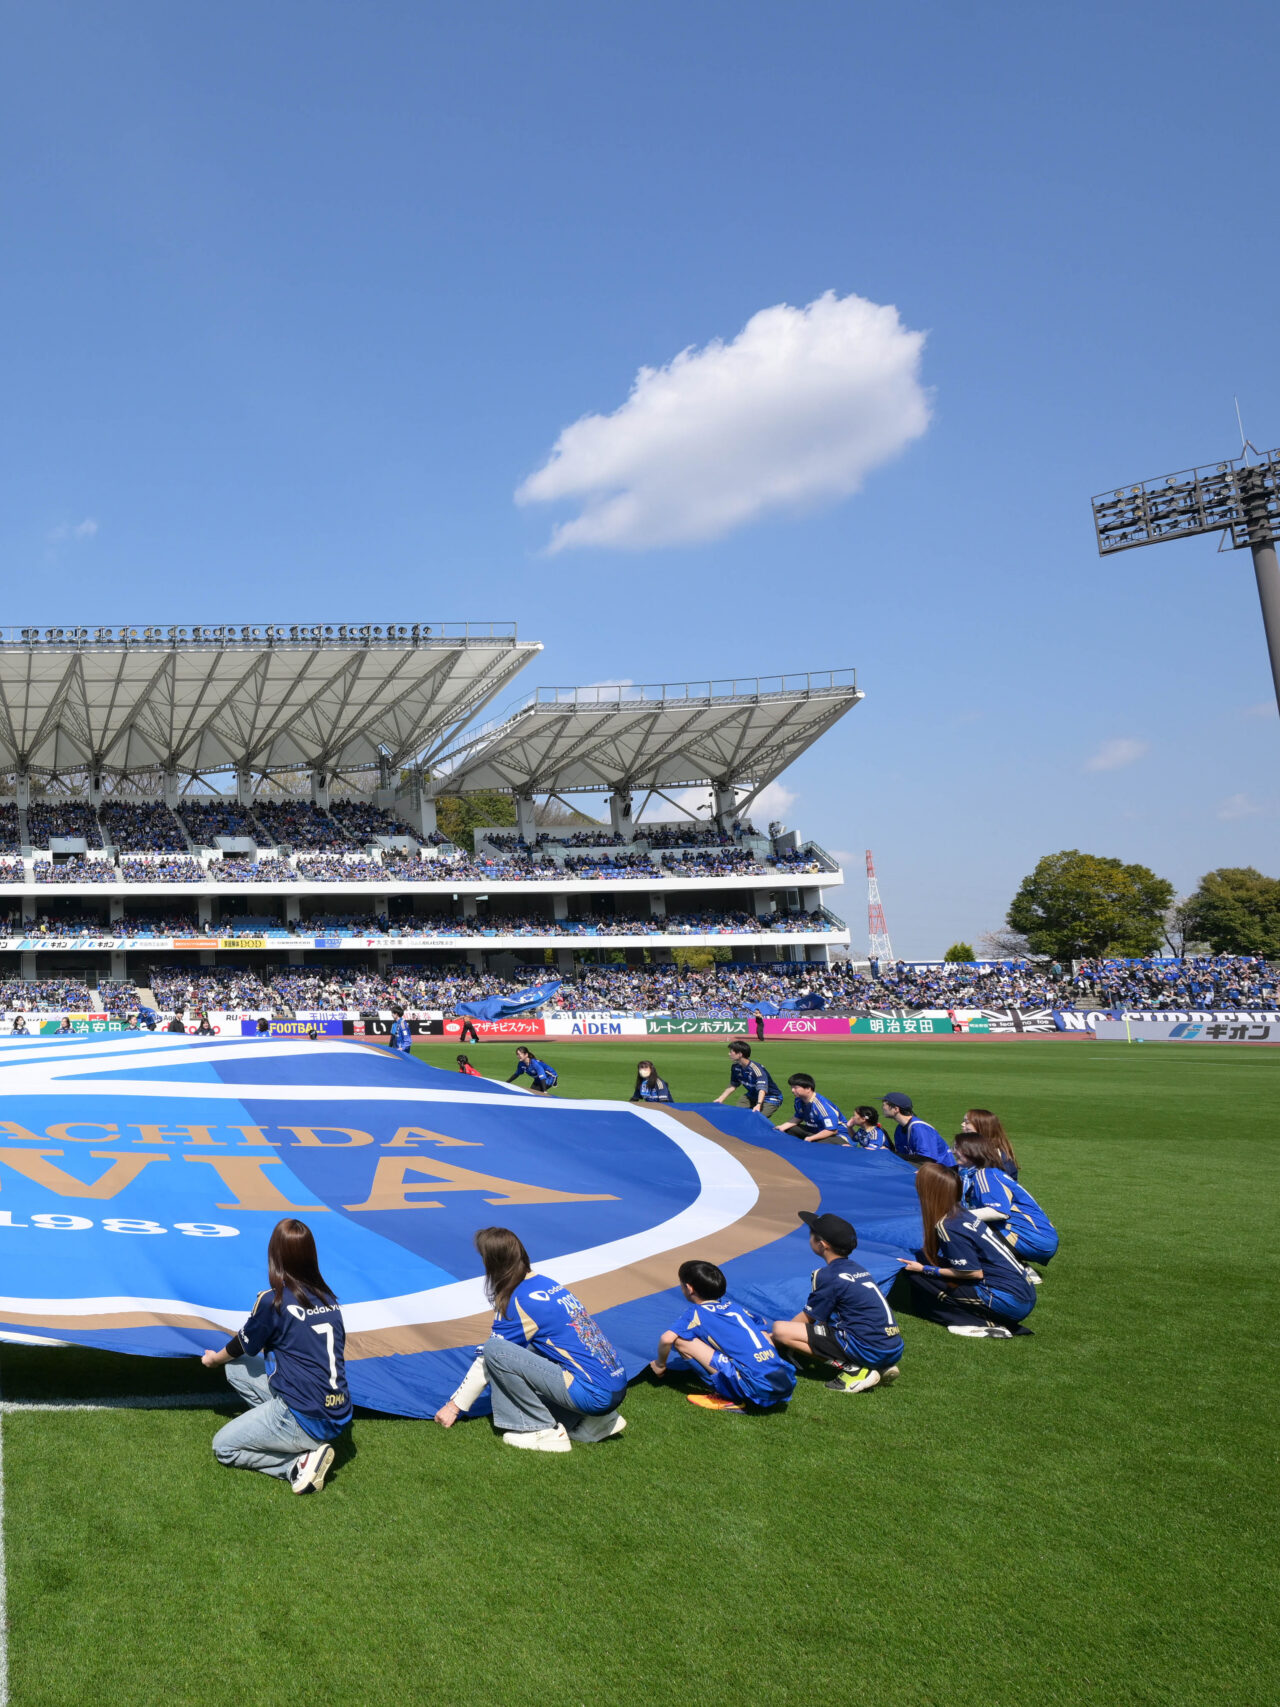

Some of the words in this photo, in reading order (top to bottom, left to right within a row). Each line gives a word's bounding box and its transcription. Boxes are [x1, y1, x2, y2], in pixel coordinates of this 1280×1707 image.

[70, 1021, 122, 1033] 治安田
[256, 1022, 327, 1033] FOOTBALL
[372, 1021, 433, 1035] いご
[472, 1021, 540, 1033] マザキビスケット
[648, 1022, 698, 1033] ルートイン
[699, 1021, 746, 1033] ホテルズ
[869, 1019, 934, 1033] 明治安田
[1205, 1024, 1271, 1040] ギオン
[861, 1281, 894, 1325] 7
[724, 1311, 763, 1349] 7
[311, 1322, 339, 1390] 7
[753, 1349, 775, 1363] SOMA
[324, 1392, 346, 1407] SOMA
